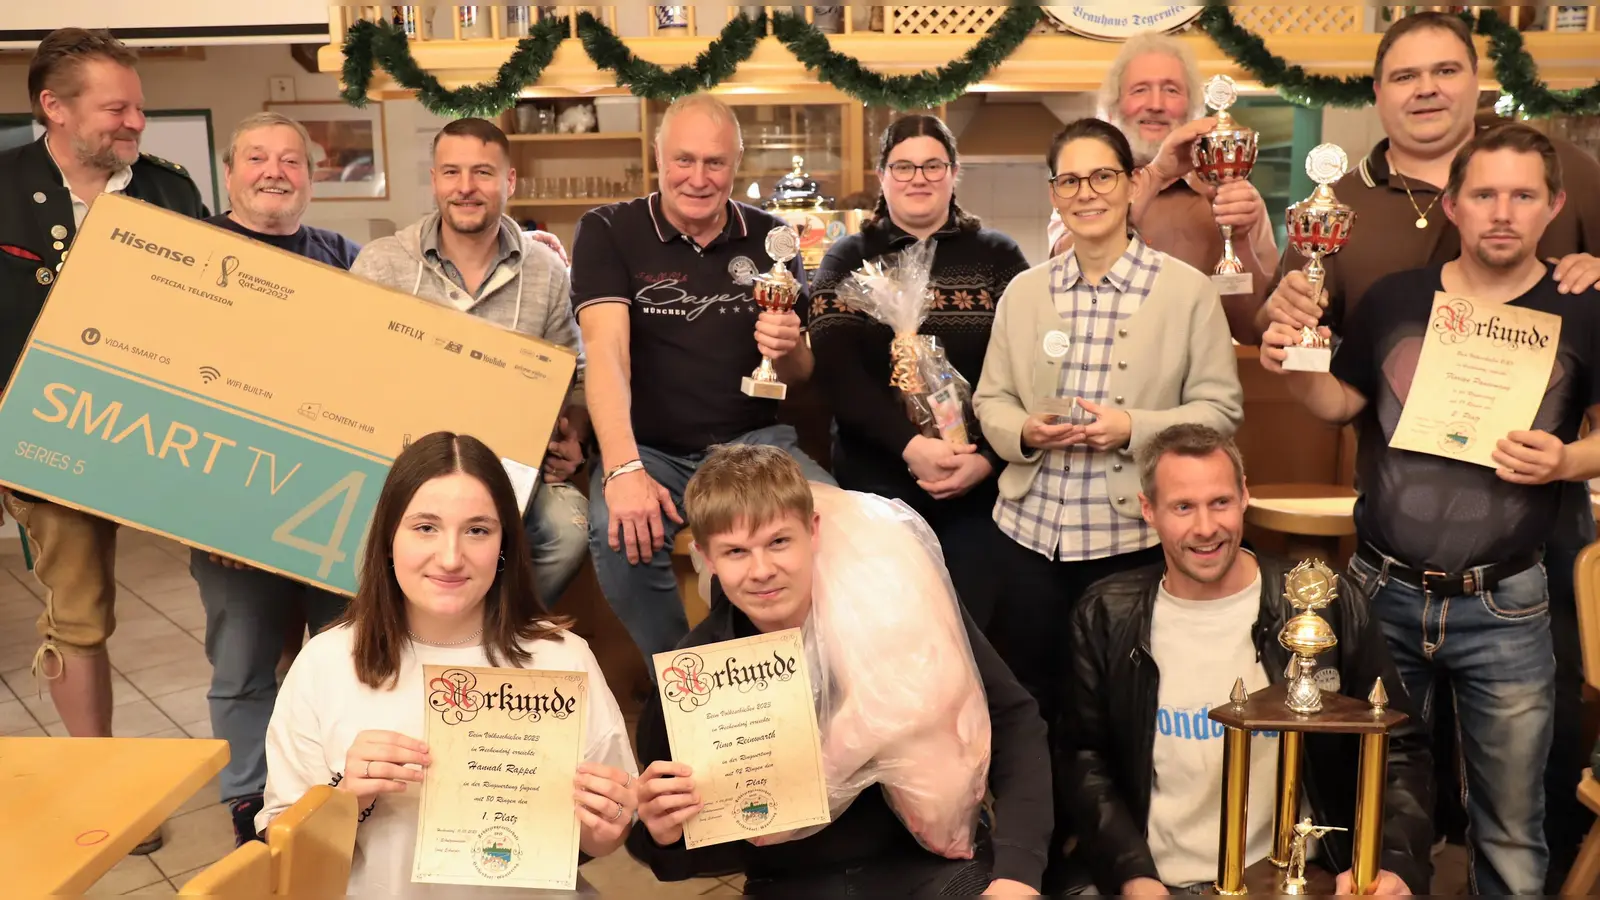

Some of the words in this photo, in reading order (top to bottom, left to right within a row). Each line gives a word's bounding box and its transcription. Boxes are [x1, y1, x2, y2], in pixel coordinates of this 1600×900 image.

[110, 228, 196, 266] Hisense
[150, 274, 186, 291] OFFICIAL
[188, 286, 234, 306] TELEVISION
[238, 271, 254, 282] FIFA
[252, 275, 280, 291] WORLD
[280, 285, 295, 295] CUP
[635, 278, 754, 322] Bayer
[643, 307, 686, 316] MÜNCHEN
[388, 320, 426, 342] NETFLIX
[1432, 298, 1549, 350] Urkunde
[104, 337, 130, 352] VIDAA
[131, 345, 158, 362] SMART
[158, 356, 172, 366] OS
[483, 354, 507, 369] YouTube
[226, 377, 242, 390] WIFI
[243, 383, 274, 400] BUILT-IN
[322, 411, 359, 430] CONTENT
[358, 422, 376, 434] HUB
[32, 382, 237, 474] SMART
[245, 446, 302, 496] TV
[14, 440, 72, 471] SERIES
[72, 460, 86, 476] 5
[271, 470, 378, 583] 4
[662, 650, 797, 712] Urkunde
[428, 668, 577, 726] Urkunde
[756, 702, 772, 710] 2023
[479, 746, 510, 756] Hechendorf
[713, 740, 732, 750] Timo
[736, 730, 776, 746] Reinwarth
[468, 760, 502, 772] Hannah
[506, 764, 538, 776] Rappel
[483, 782, 518, 791] Ringwertung
[520, 784, 540, 792] Jugend
[746, 778, 768, 788] Platz
[496, 796, 516, 804] Ringen
[482, 812, 488, 820] 1.
[494, 812, 518, 825] Platz
